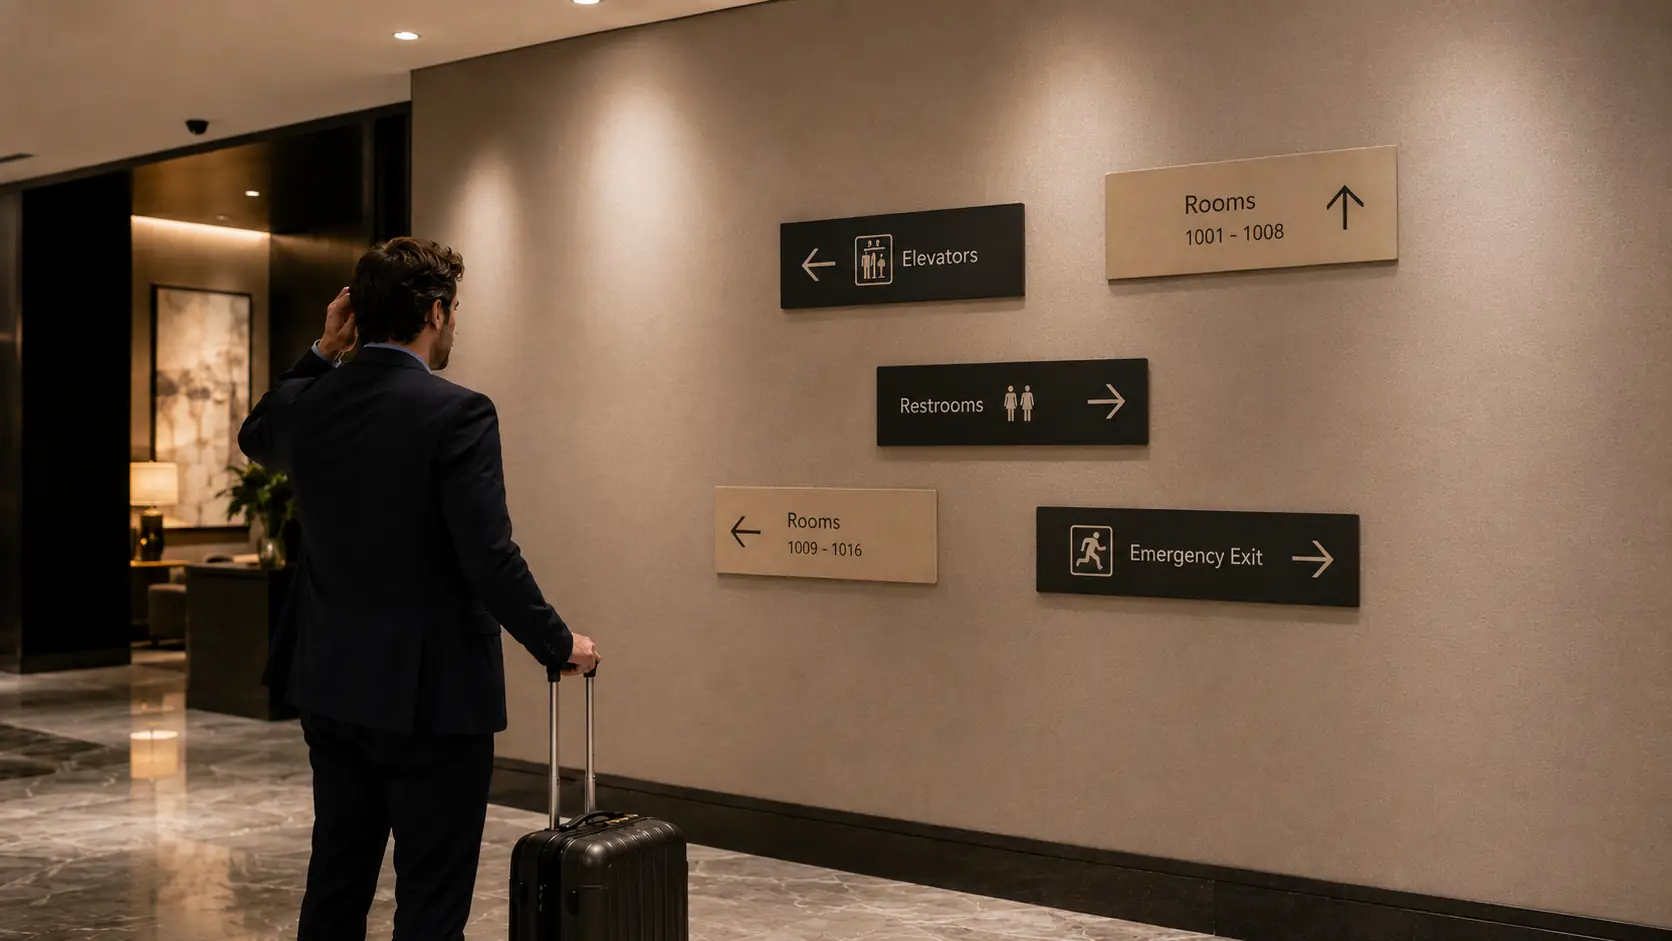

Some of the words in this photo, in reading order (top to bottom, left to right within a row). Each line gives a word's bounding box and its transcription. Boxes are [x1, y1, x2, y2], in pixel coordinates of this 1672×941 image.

[1185, 195, 1257, 215] Rooms
[1186, 227, 1223, 246] 1001
[1243, 223, 1285, 242] 1008
[902, 249, 979, 267] Elevators
[900, 397, 985, 414] Restrooms
[787, 512, 841, 530] Rooms
[788, 540, 818, 556] 1009
[832, 542, 863, 557] 1016
[1130, 543, 1224, 569] Emergency
[1231, 547, 1264, 566] Exit
